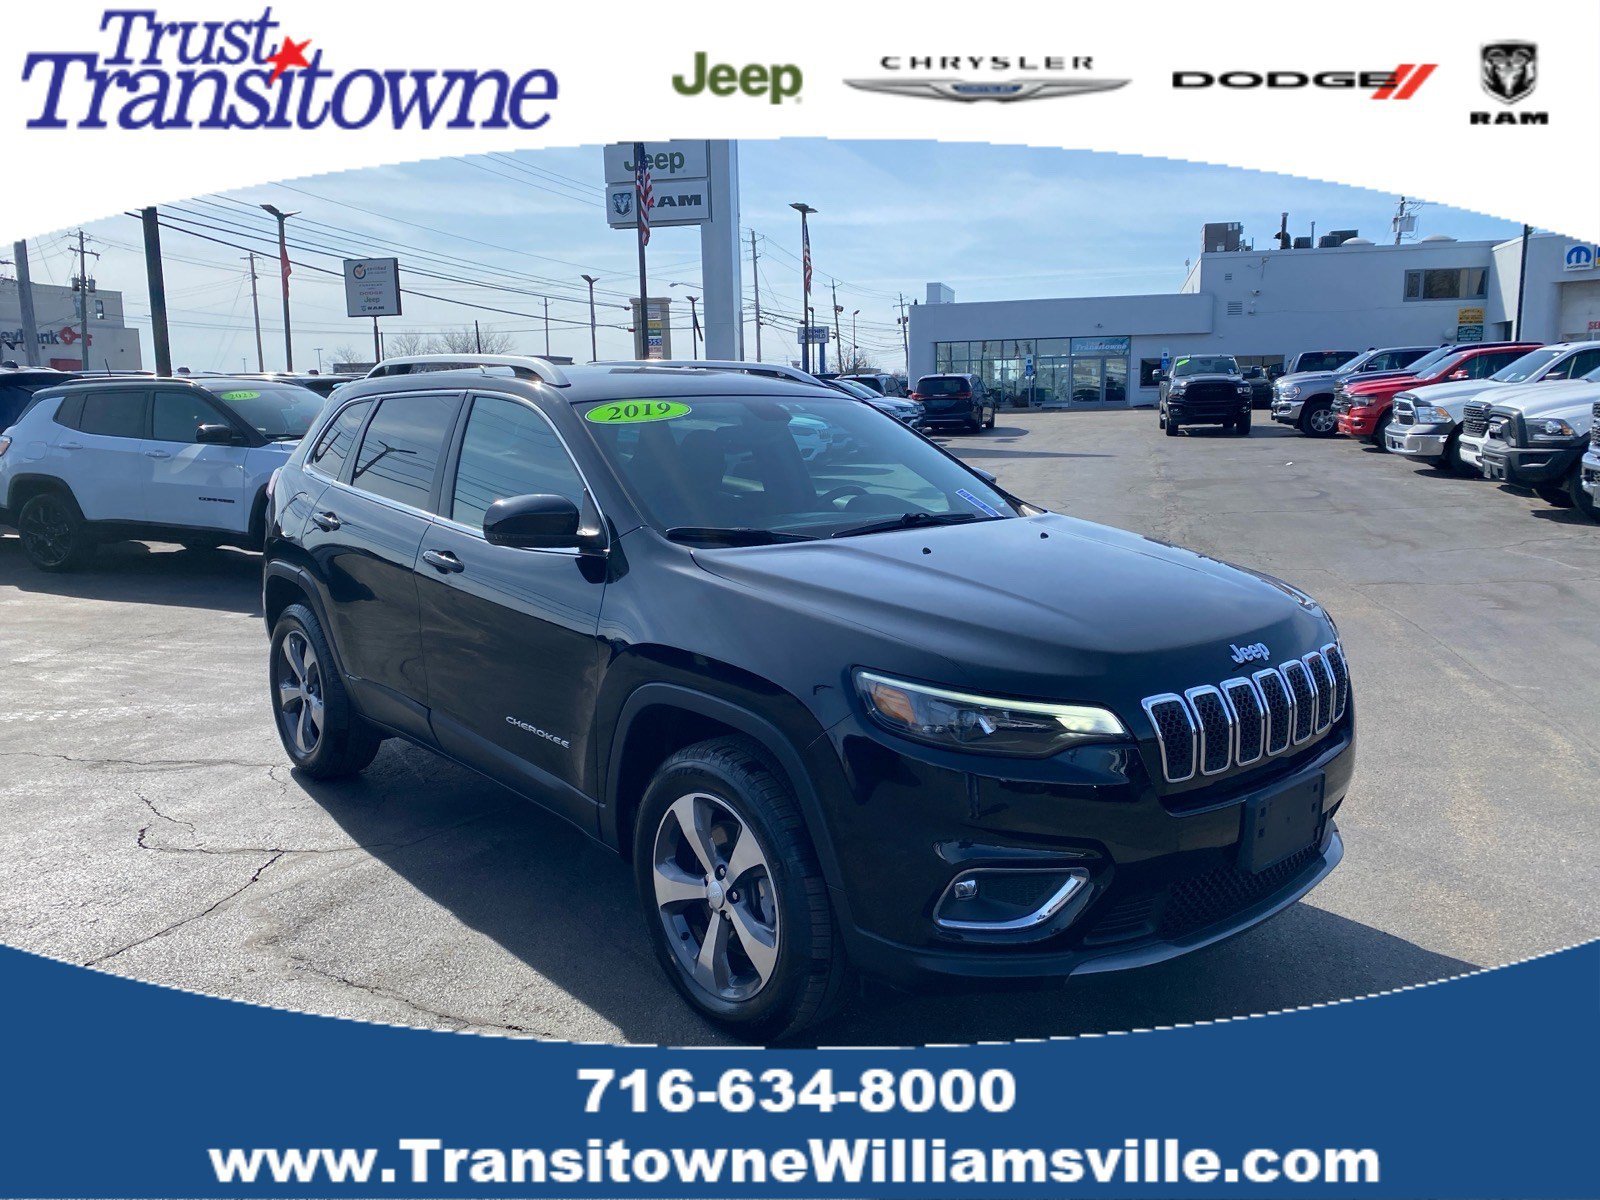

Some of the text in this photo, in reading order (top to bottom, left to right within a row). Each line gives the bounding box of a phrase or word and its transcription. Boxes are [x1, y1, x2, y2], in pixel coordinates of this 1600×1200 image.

[649, 195, 701, 208] AM
[607, 402, 671, 420] 2019
[1230, 642, 1270, 663] Jeep
[505, 716, 570, 748] CHEROKEE
